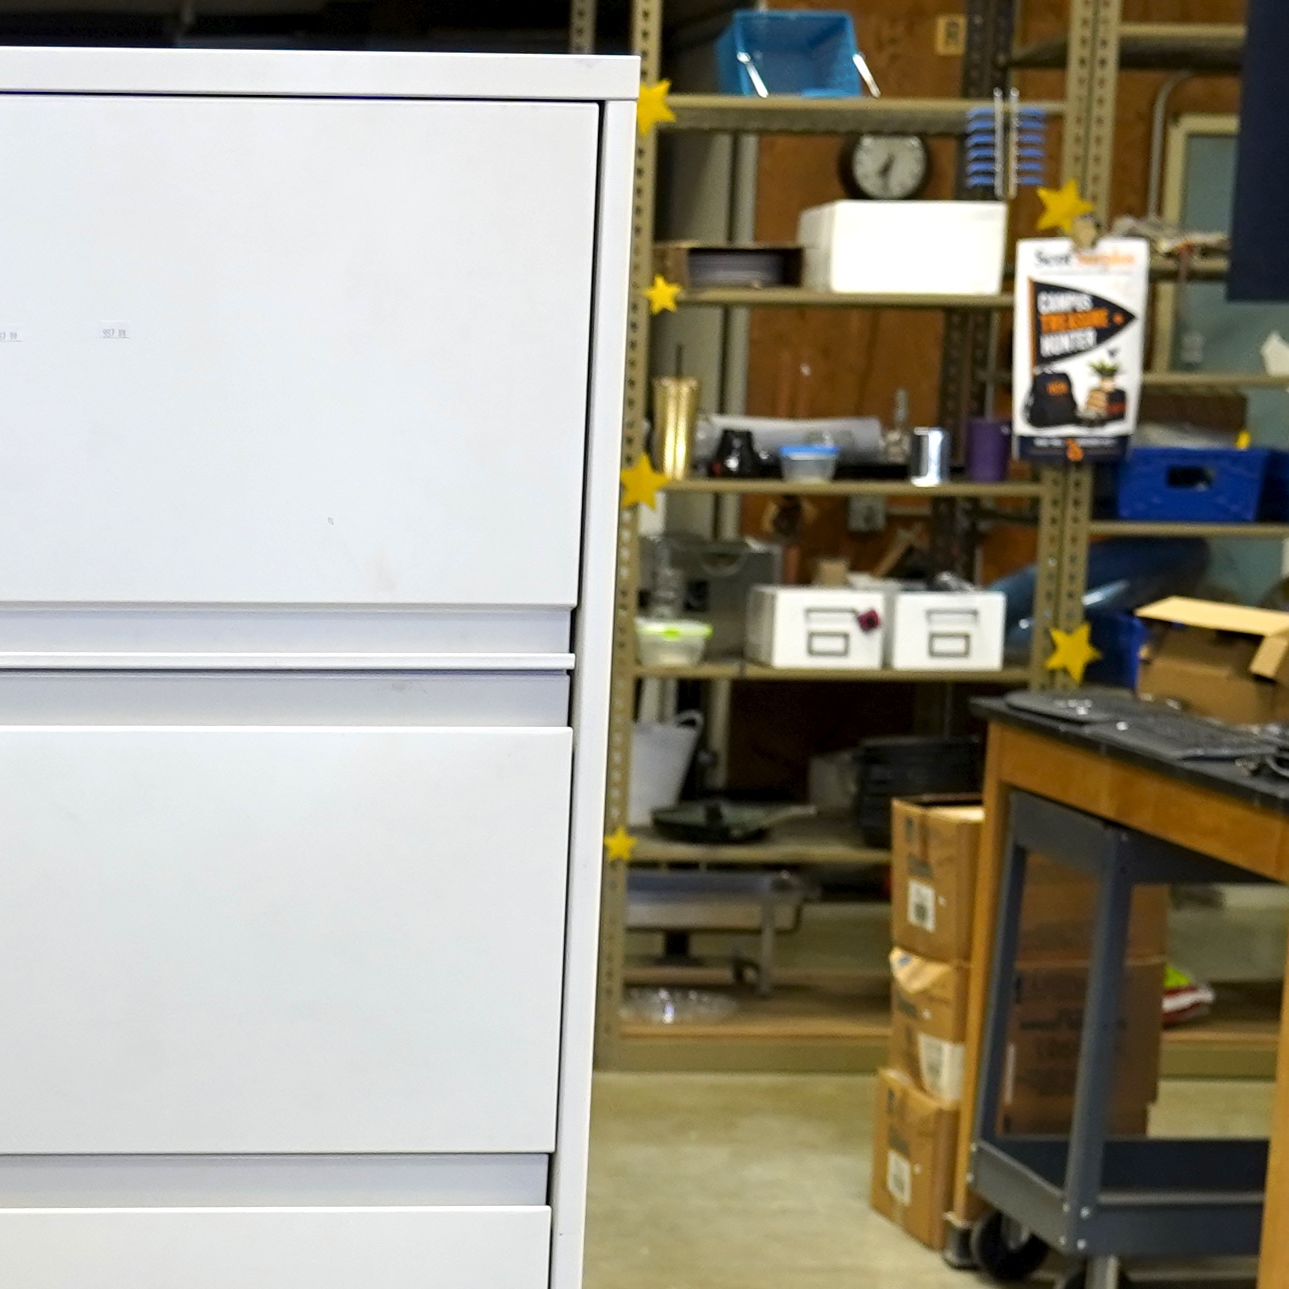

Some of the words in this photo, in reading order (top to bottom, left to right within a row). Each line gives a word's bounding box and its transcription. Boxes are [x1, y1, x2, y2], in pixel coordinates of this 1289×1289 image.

[1037, 291, 1094, 315] CAMPUS
[1040, 308, 1109, 334] TREASURE
[1040, 327, 1097, 357] HUNTER
